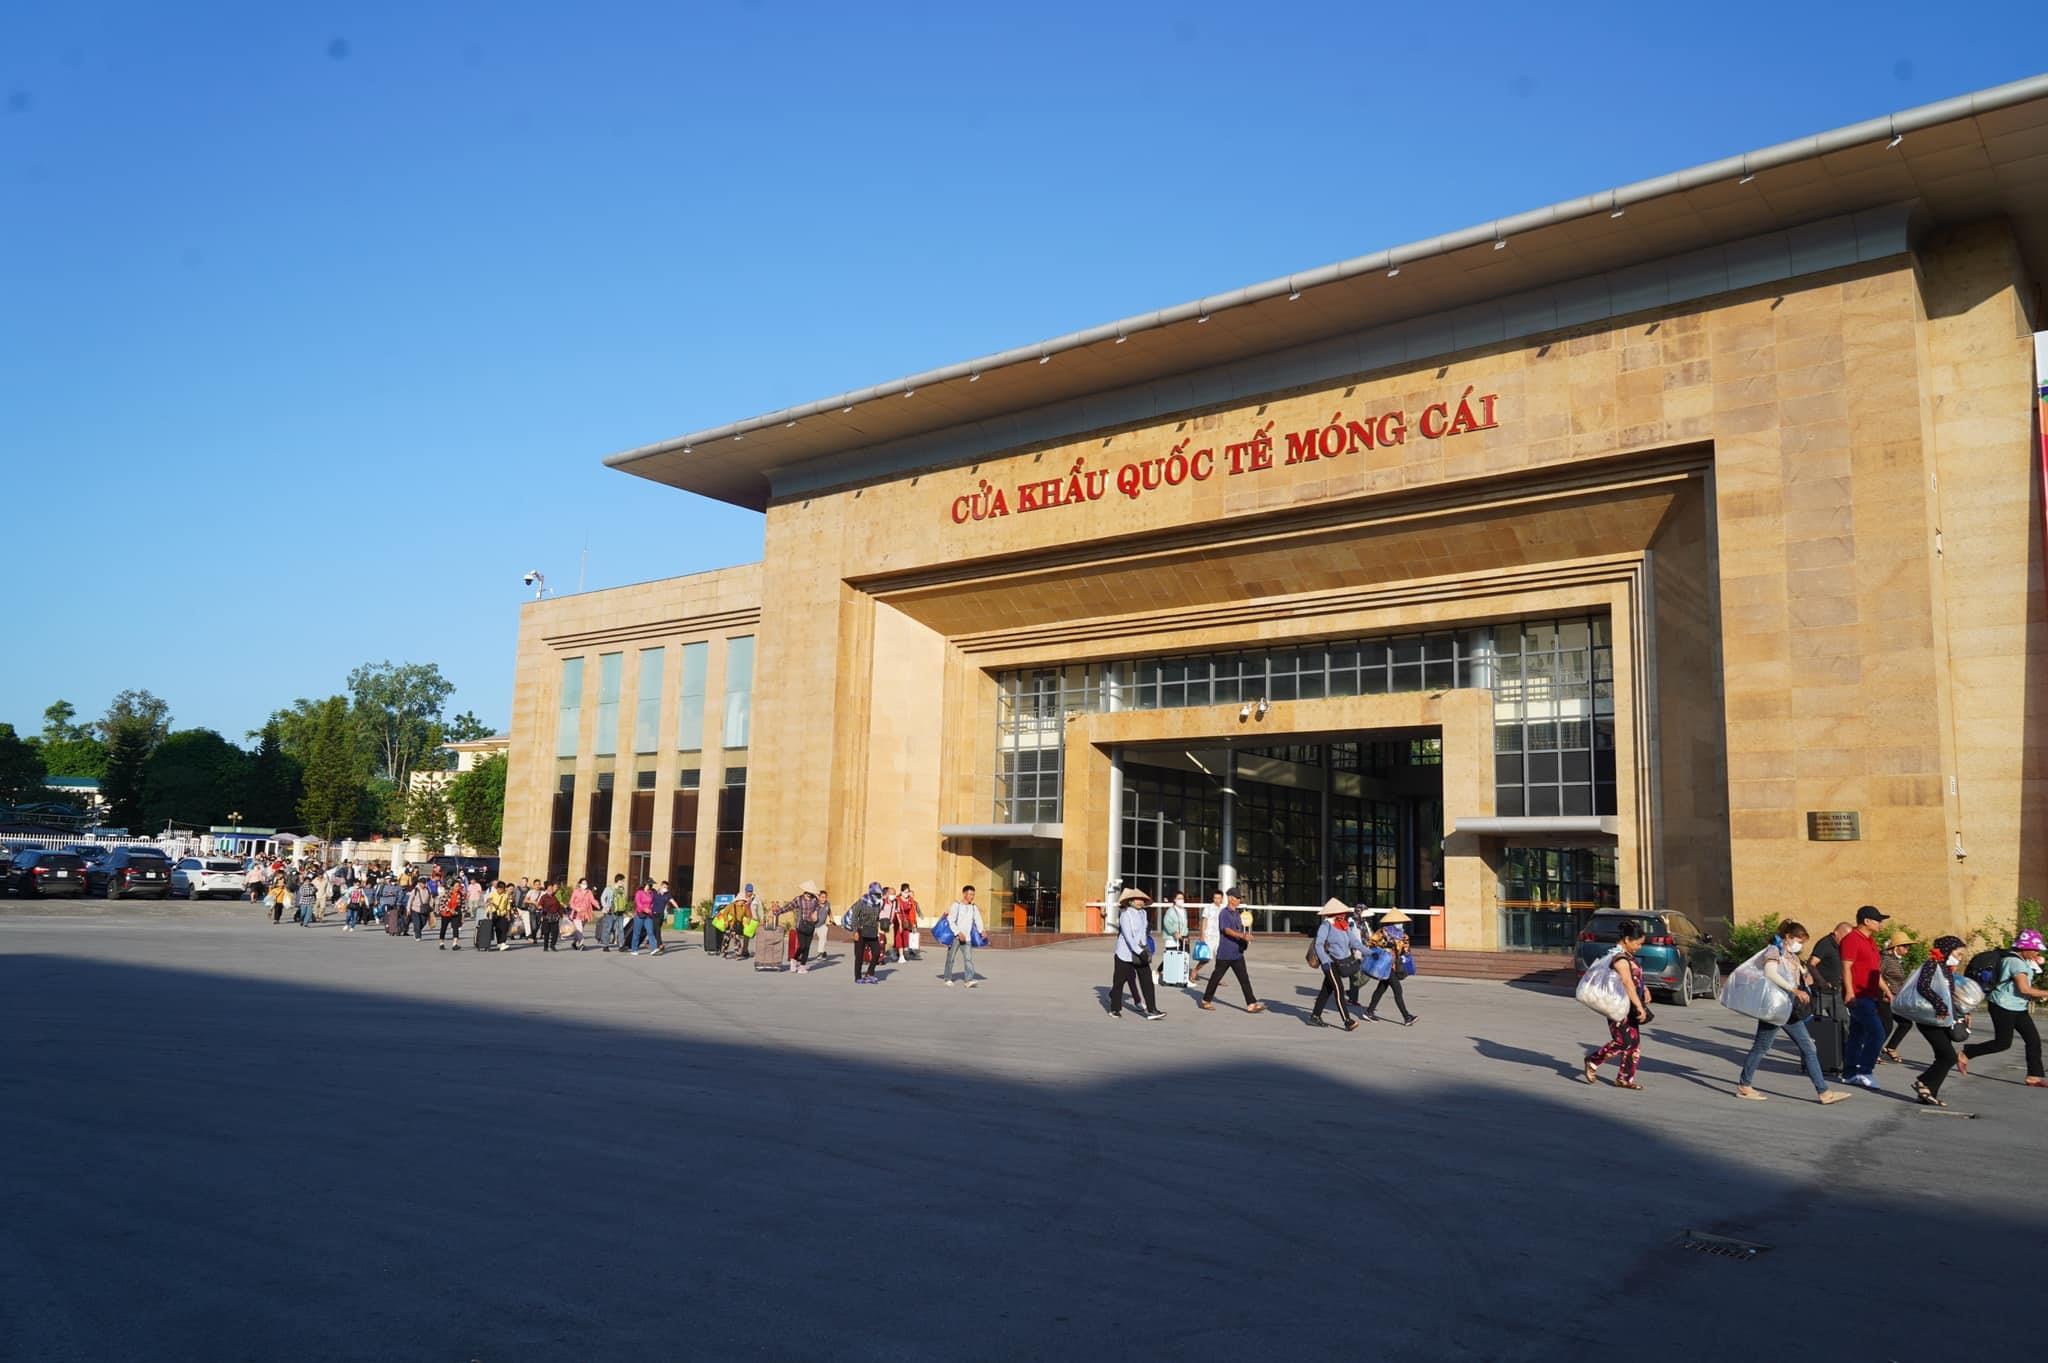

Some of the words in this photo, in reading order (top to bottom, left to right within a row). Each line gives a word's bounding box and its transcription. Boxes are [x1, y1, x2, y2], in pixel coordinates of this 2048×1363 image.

[952, 479, 1009, 524] CỬA
[1017, 457, 1109, 513] KHẨU
[1117, 437, 1213, 499] QUỐC
[1224, 420, 1275, 475] TẾ
[1285, 411, 1407, 465] MÓNG
[1420, 385, 1498, 439] CÁI
